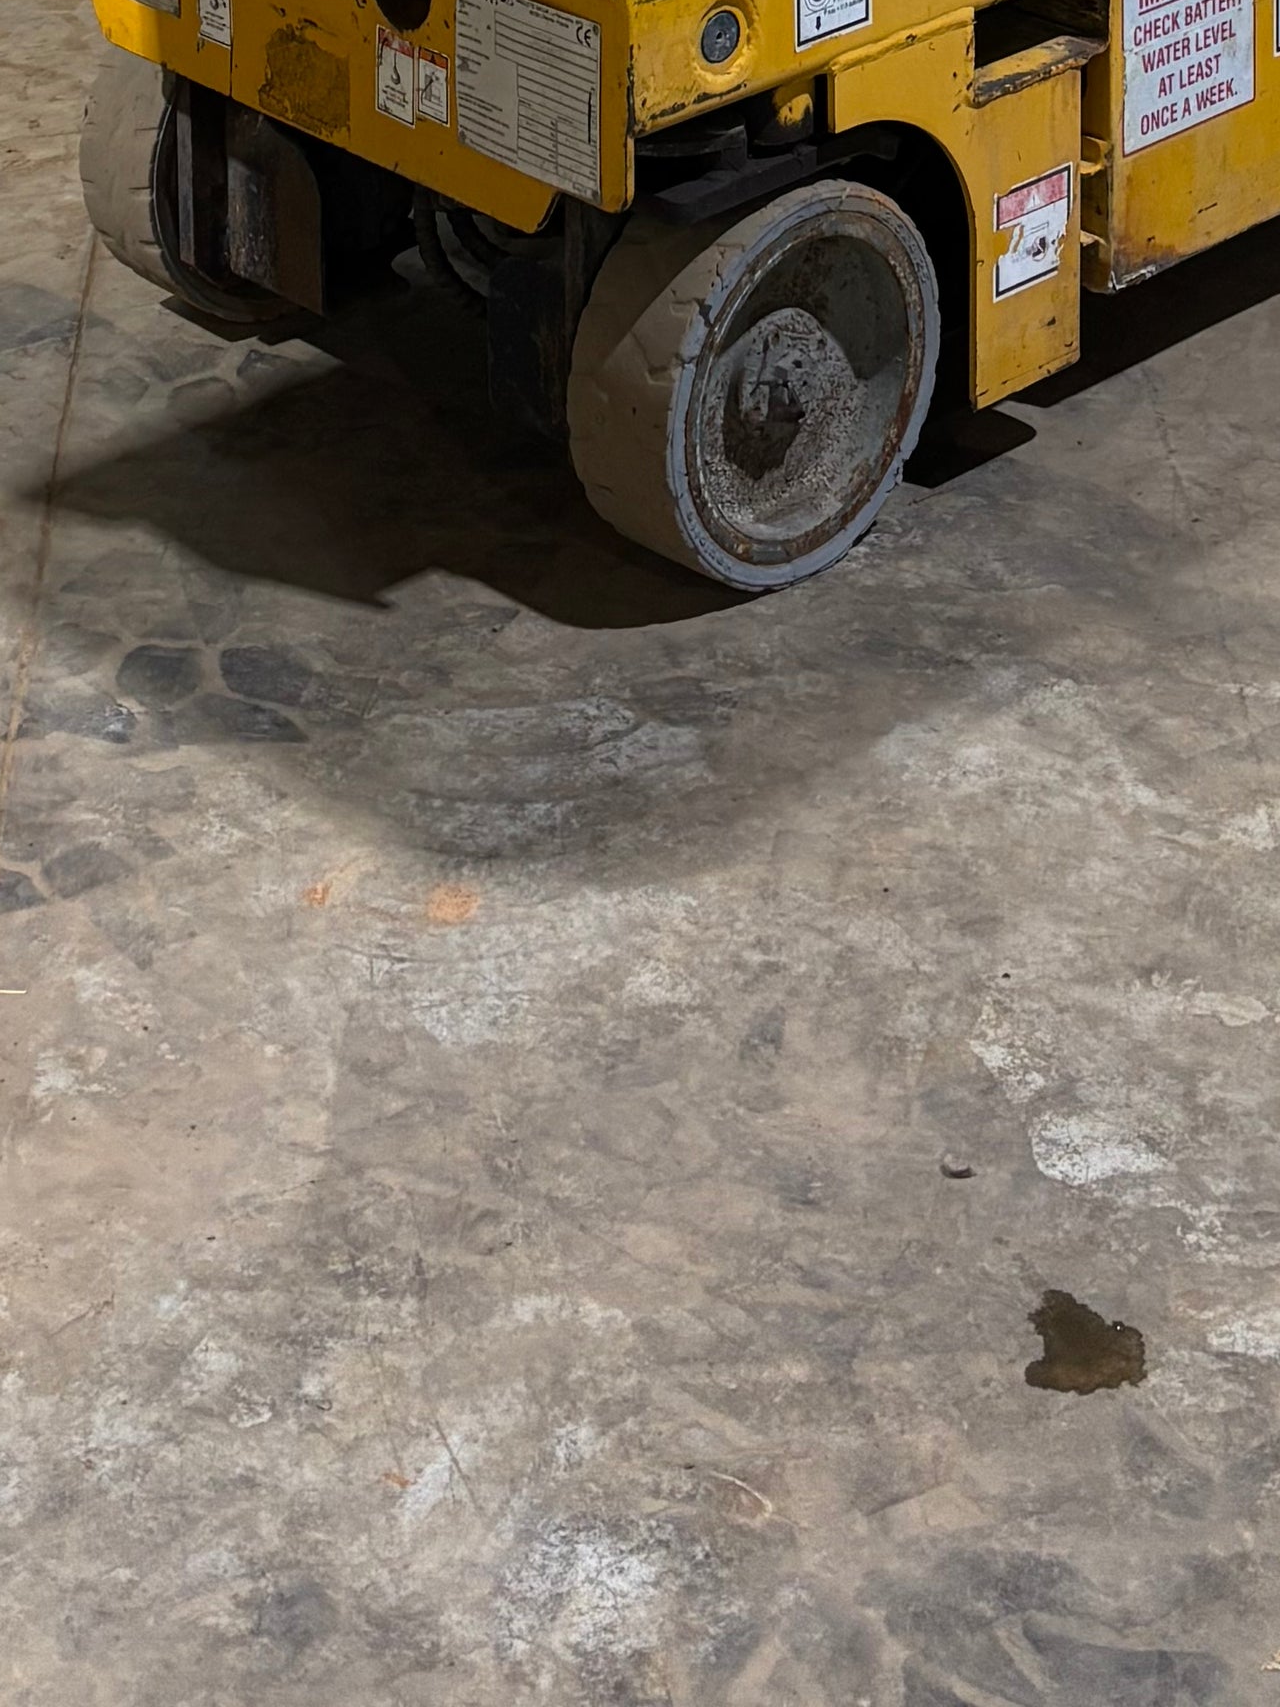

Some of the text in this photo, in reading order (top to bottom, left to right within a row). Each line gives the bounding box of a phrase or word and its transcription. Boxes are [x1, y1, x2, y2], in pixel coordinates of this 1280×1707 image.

[1133, 10, 1180, 47] CHECK
[1142, 18, 1236, 74] WATER LEVEL
[1158, 53, 1222, 98] AT LEAST
[1140, 77, 1238, 135] ONCE A WEEK.
